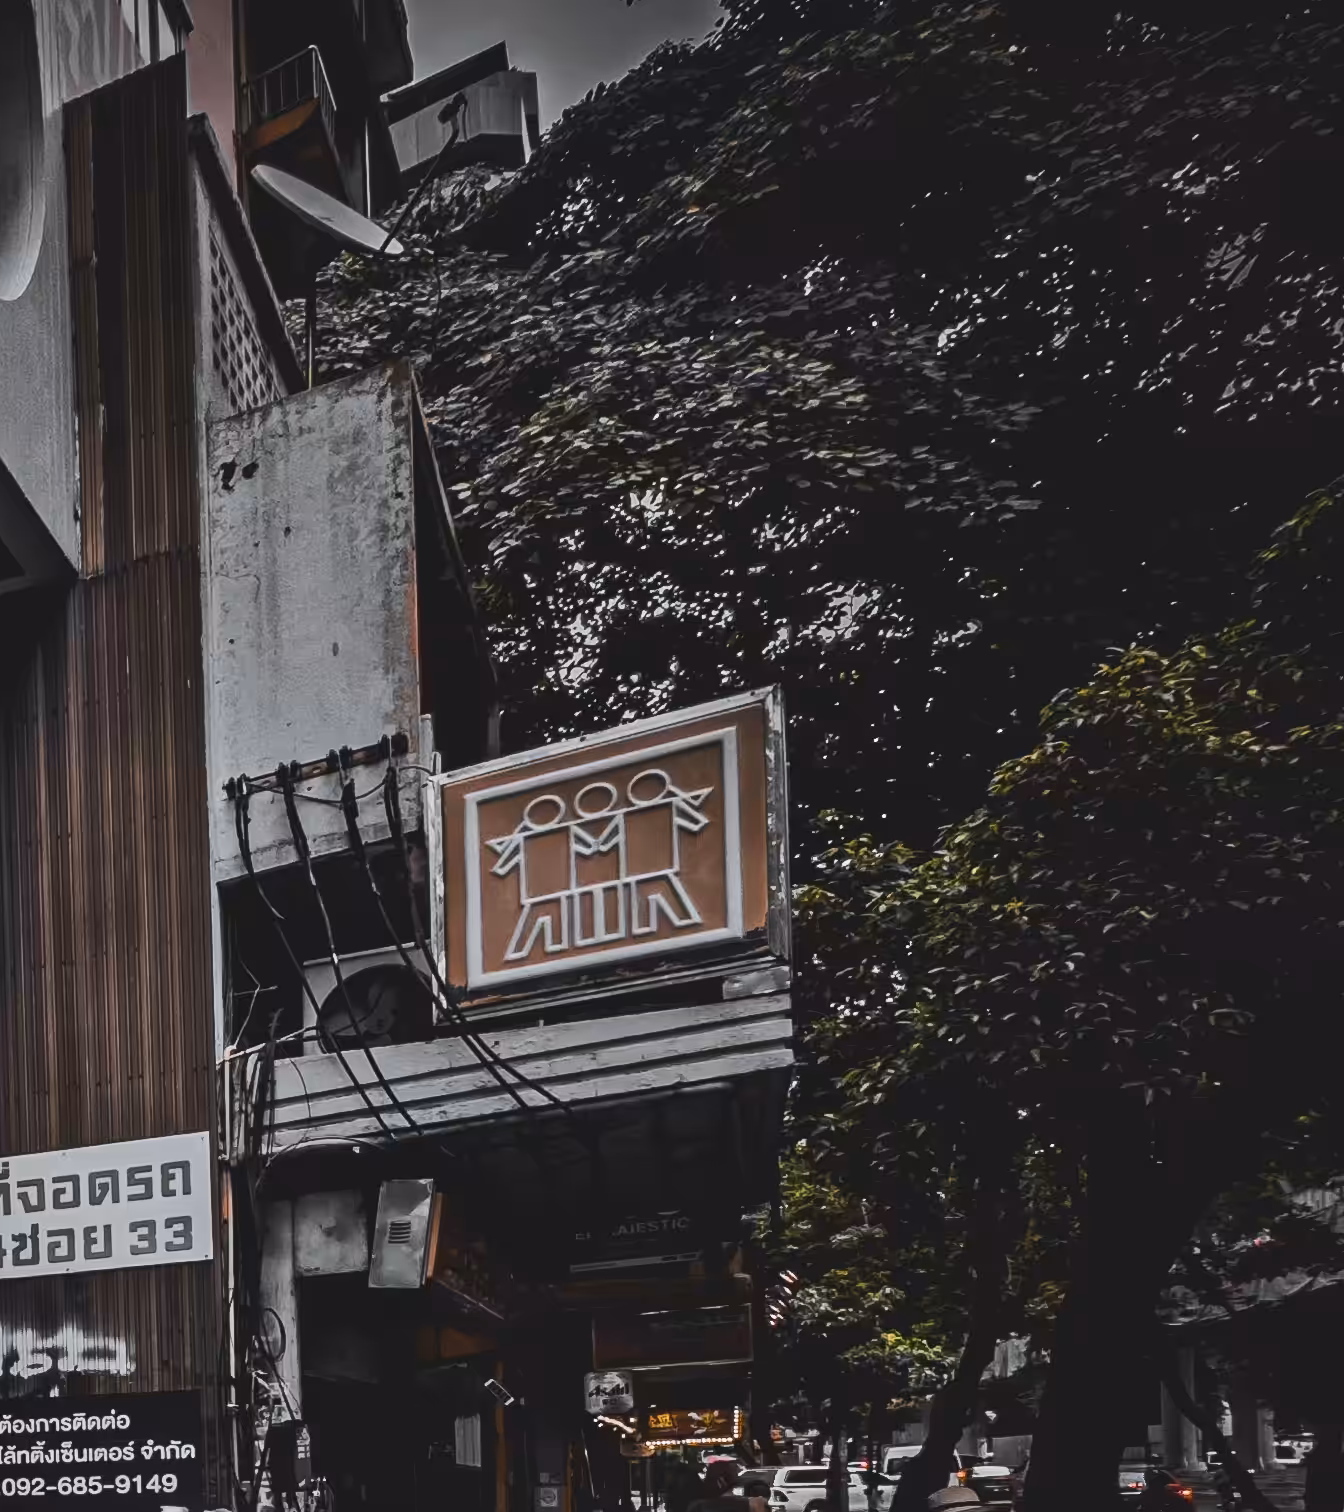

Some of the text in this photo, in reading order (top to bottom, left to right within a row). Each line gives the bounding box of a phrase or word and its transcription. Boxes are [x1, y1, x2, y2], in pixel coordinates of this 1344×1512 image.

[128, 1215, 193, 1256] 33
[611, 1215, 691, 1239] AJESTIC
[140, 1439, 196, 1461] จำกัด
